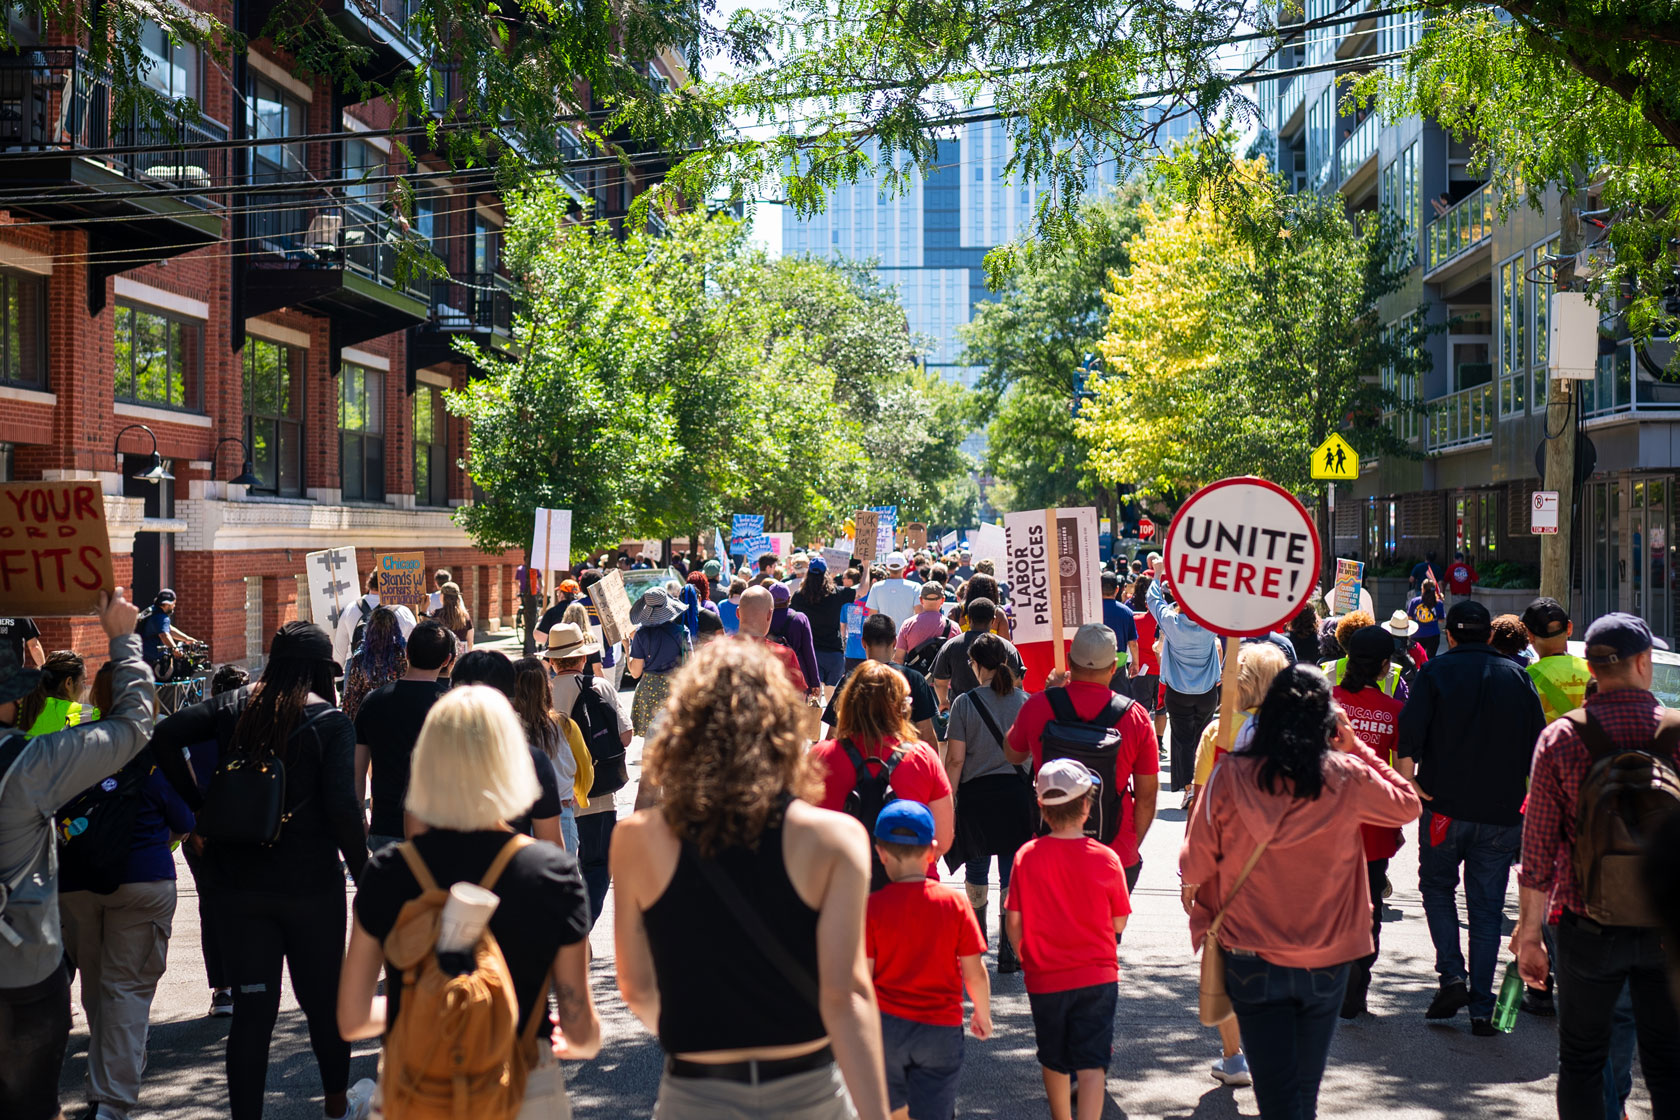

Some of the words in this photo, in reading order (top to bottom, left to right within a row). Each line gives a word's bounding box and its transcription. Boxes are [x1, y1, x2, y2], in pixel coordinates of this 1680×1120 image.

[6, 486, 99, 523] YOUR
[857, 512, 876, 527] FUCK
[1139, 524, 1153, 535] TOP
[855, 538, 870, 547] FUCK
[1185, 516, 1307, 564] UNITE
[856, 547, 869, 557] ICE
[0, 546, 103, 592] FITS
[383, 556, 420, 573] Chicago
[380, 571, 412, 586] Stands
[1014, 546, 1032, 608] LABOR
[1028, 525, 1049, 625] PRACTICES
[1177, 553, 1299, 602] HERE!
[1341, 703, 1393, 723] ICAGO
[1351, 718, 1394, 735] CHERS
[1355, 731, 1381, 745] ION
